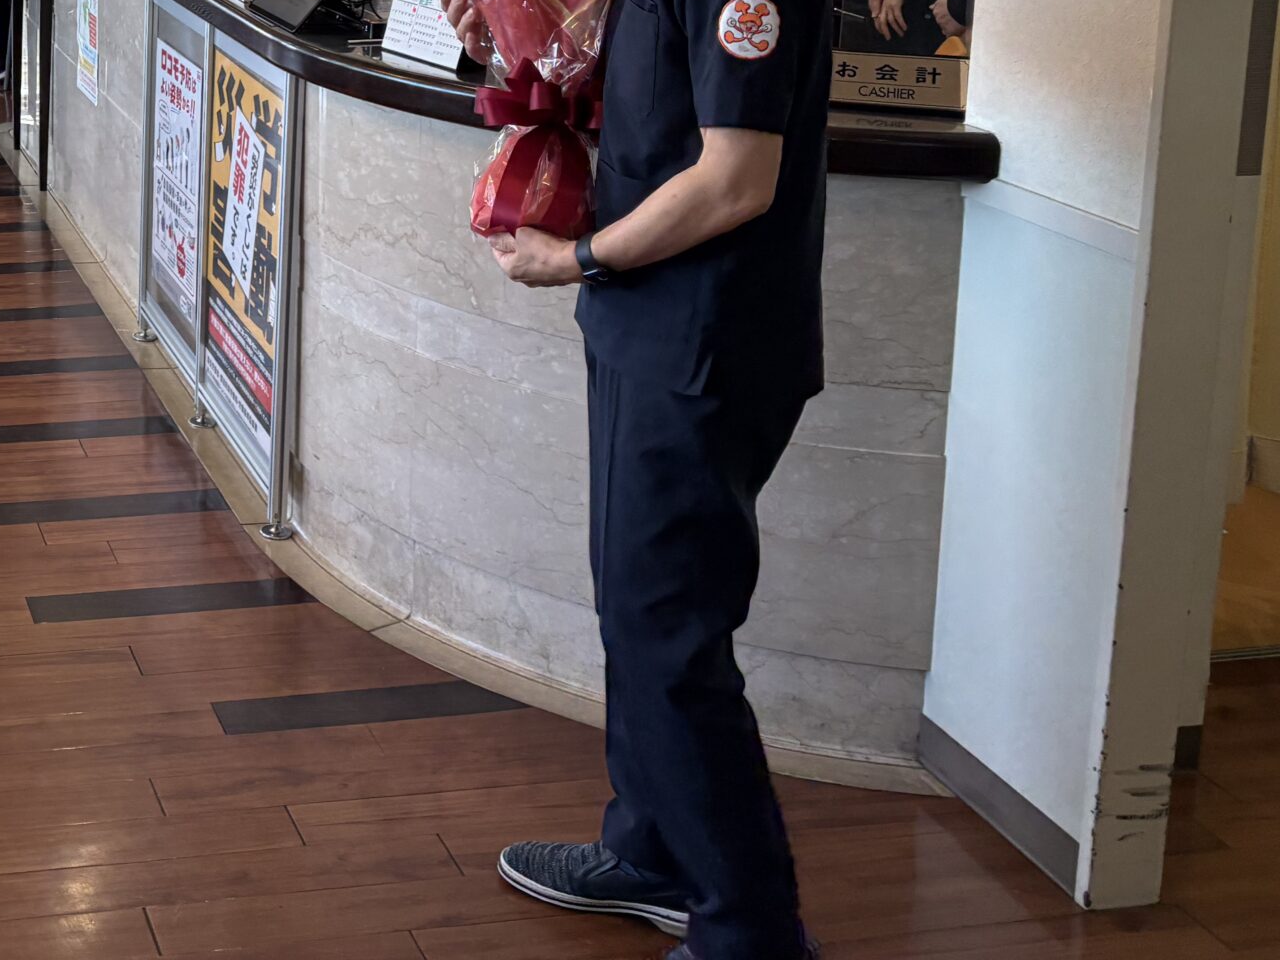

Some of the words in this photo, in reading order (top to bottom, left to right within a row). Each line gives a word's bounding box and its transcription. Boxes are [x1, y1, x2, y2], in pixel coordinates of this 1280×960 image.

[161, 49, 197, 93] ロコモ予防は
[835, 61, 942, 85] お会計
[858, 85, 916, 100] CASHIER
[229, 120, 250, 264] 犯罪です。
